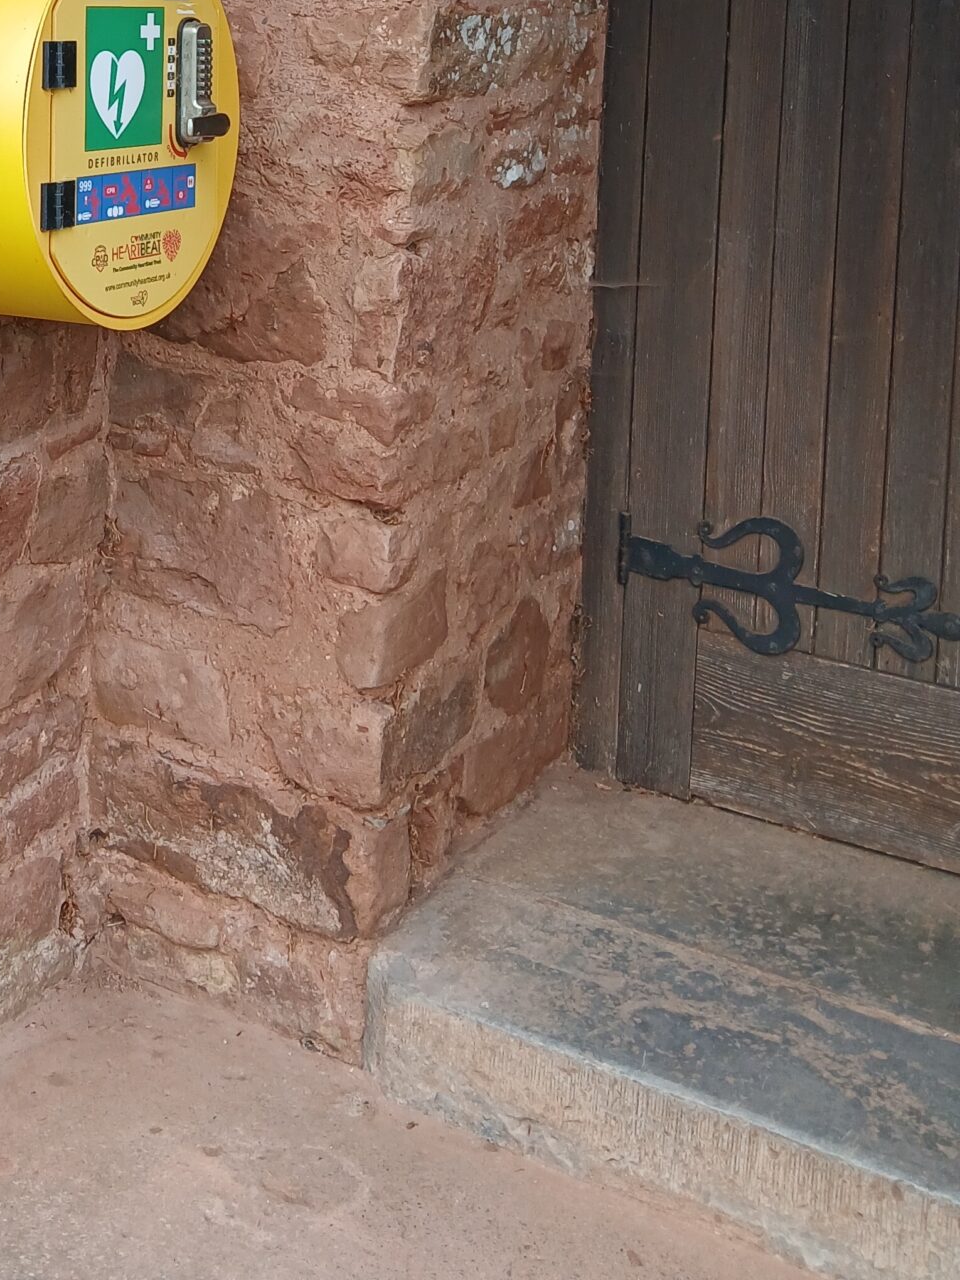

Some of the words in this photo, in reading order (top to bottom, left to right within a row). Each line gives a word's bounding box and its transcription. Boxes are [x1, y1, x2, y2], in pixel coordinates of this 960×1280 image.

[88, 151, 159, 169] DEFIBRILLATOR
[79, 180, 92, 193] 999
[112, 239, 162, 261] HEARTBEAT
